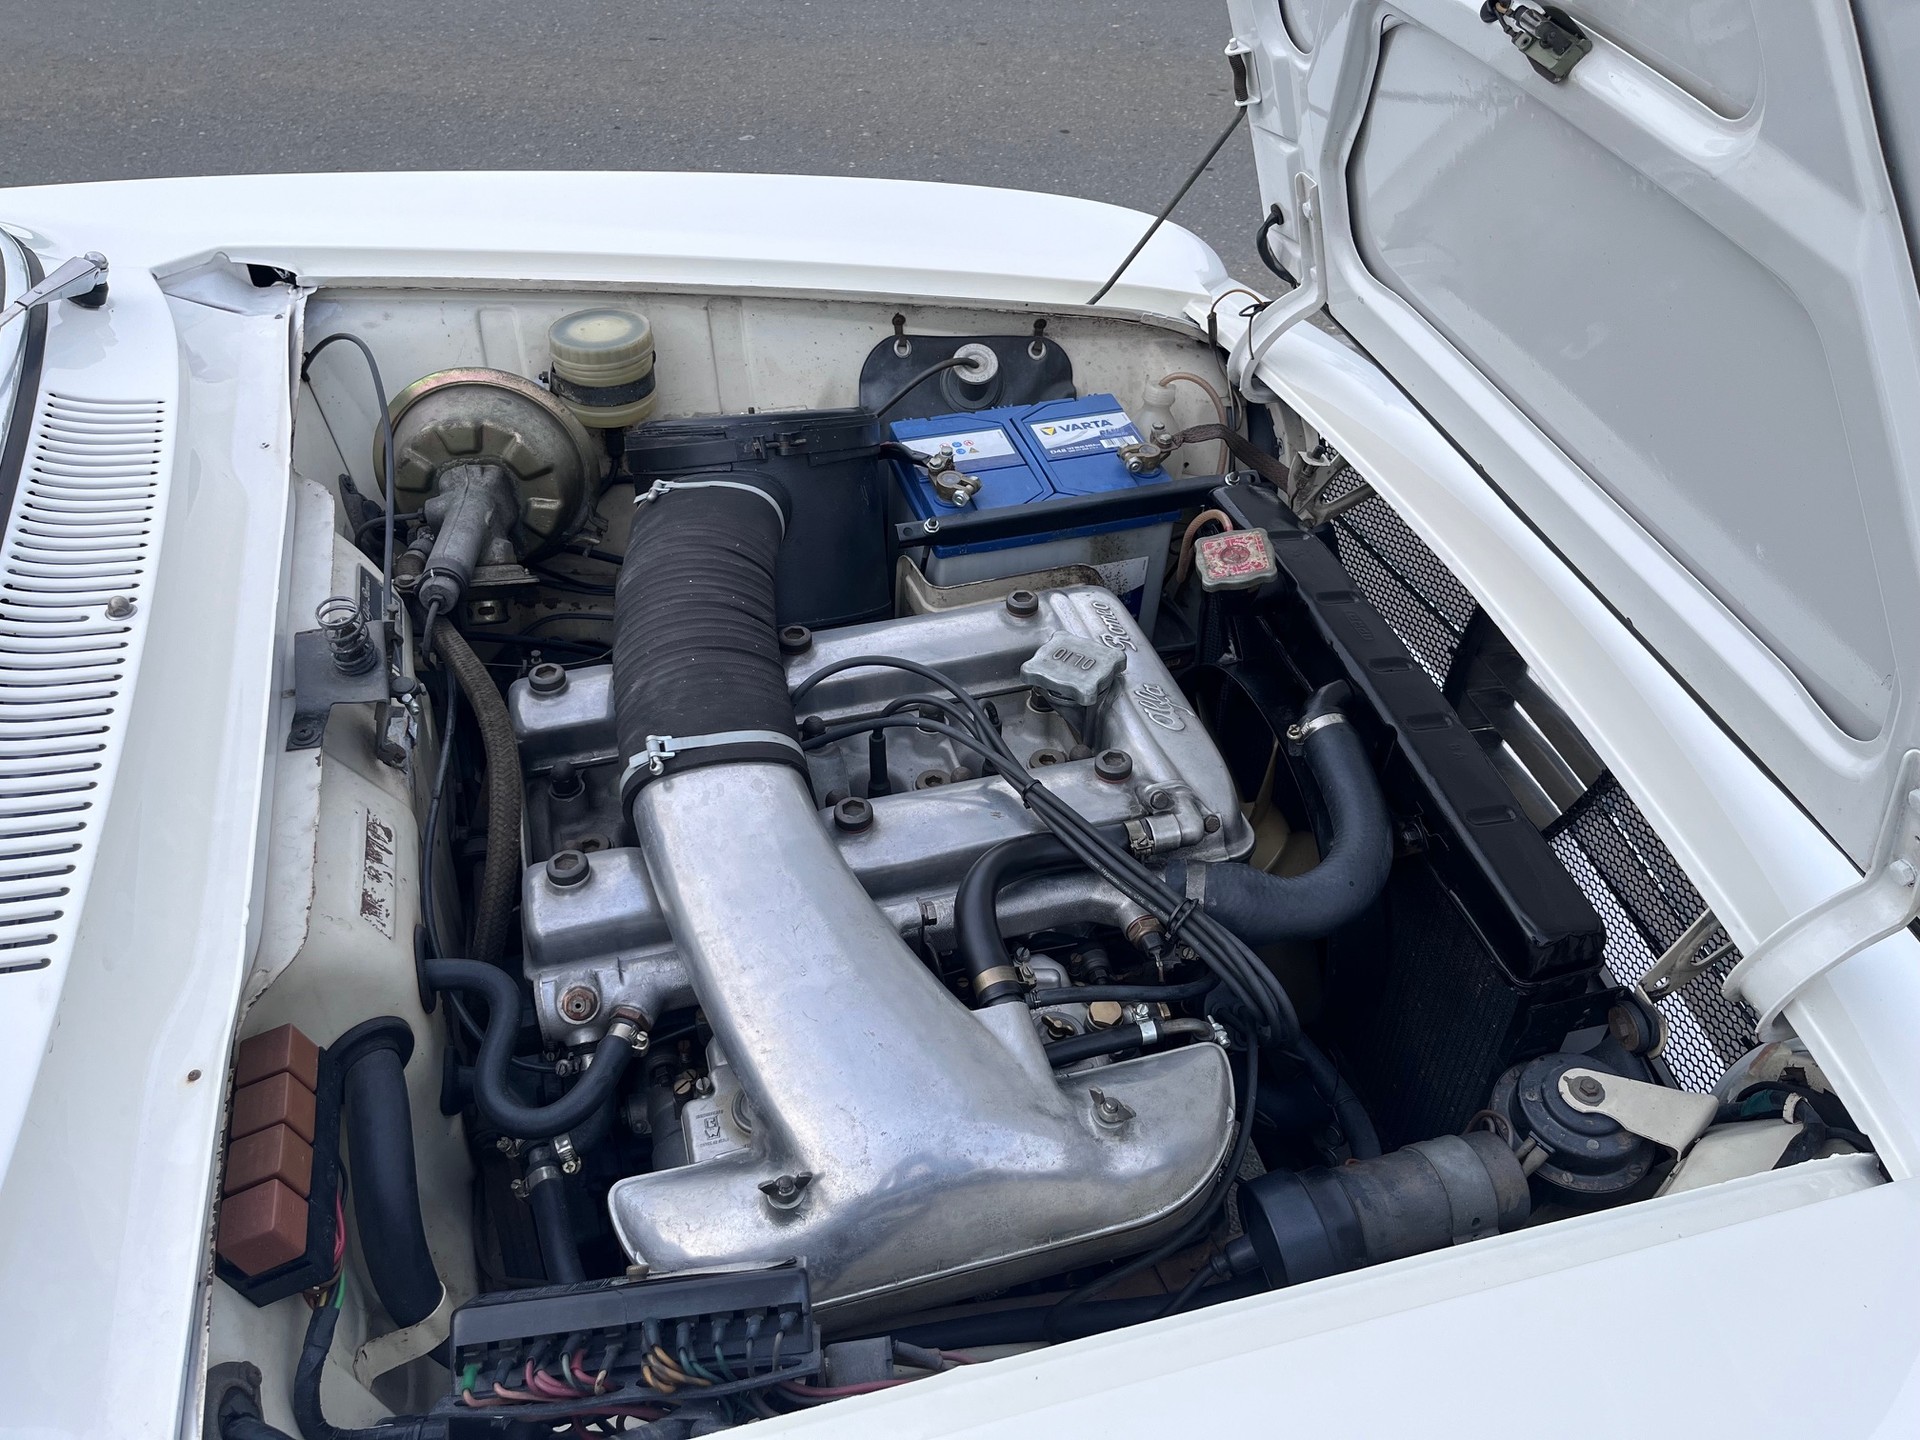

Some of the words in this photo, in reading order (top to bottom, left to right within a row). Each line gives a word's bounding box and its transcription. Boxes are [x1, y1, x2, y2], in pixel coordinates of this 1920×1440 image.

[1058, 419, 1113, 432] VARTA
[1091, 601, 1137, 651] Romeo
[1052, 648, 1096, 671] OLIO
[1134, 683, 1195, 731] Alfa
